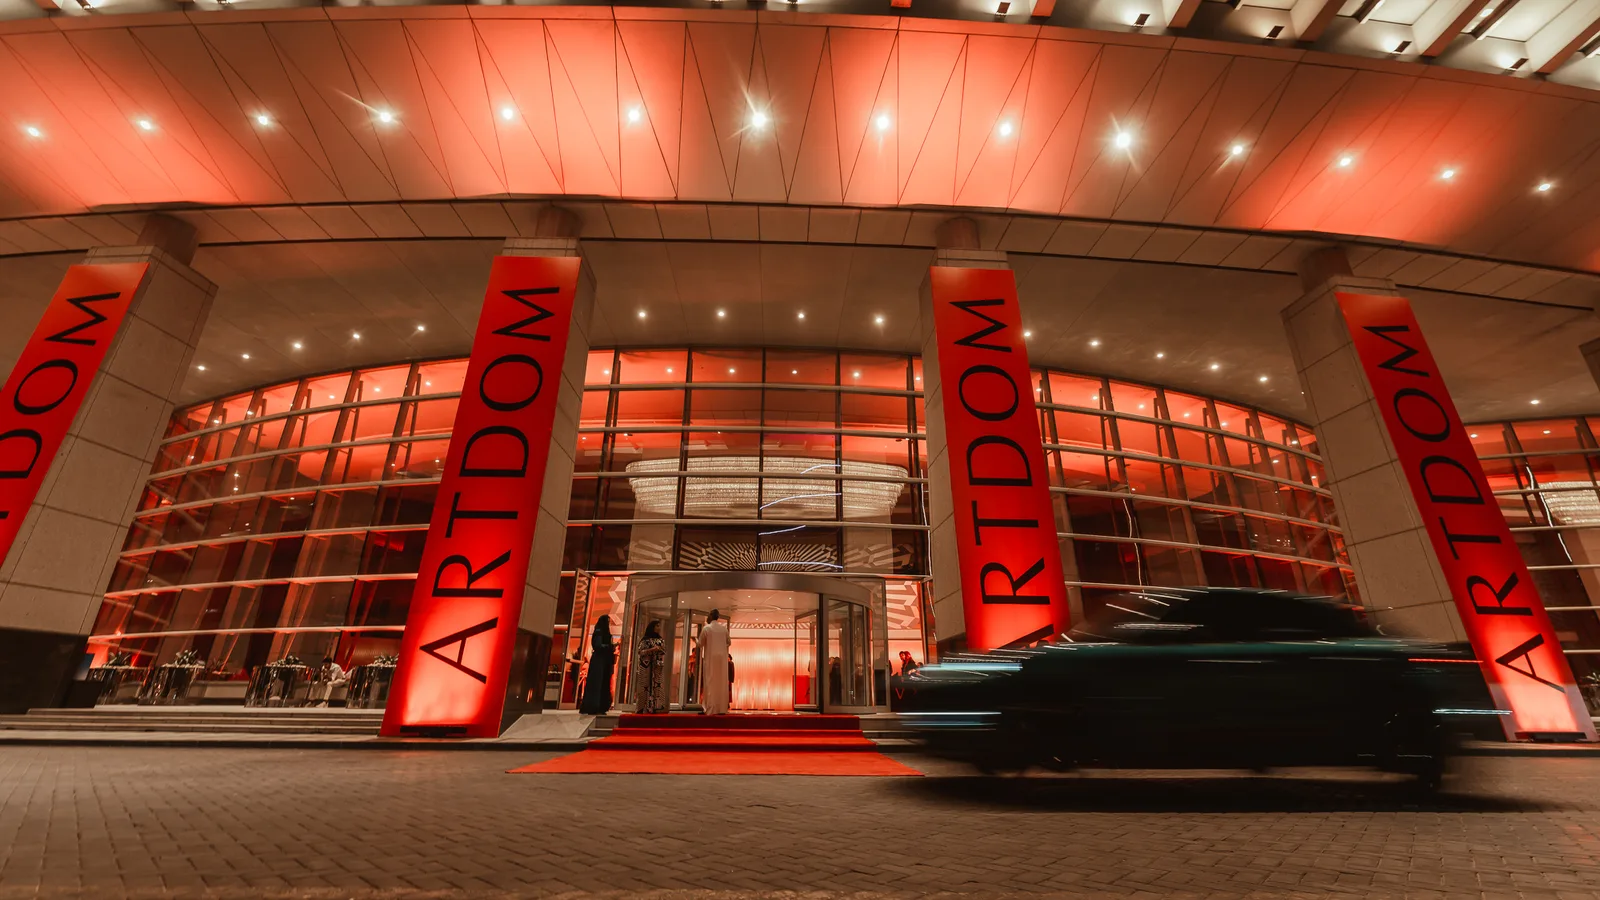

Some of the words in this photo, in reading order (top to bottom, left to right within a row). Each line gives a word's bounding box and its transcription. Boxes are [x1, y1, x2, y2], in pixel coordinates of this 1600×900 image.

[0, 291, 121, 520] DOM
[419, 286, 560, 685] ARTDOM
[1362, 324, 1565, 693] ARTDOM
